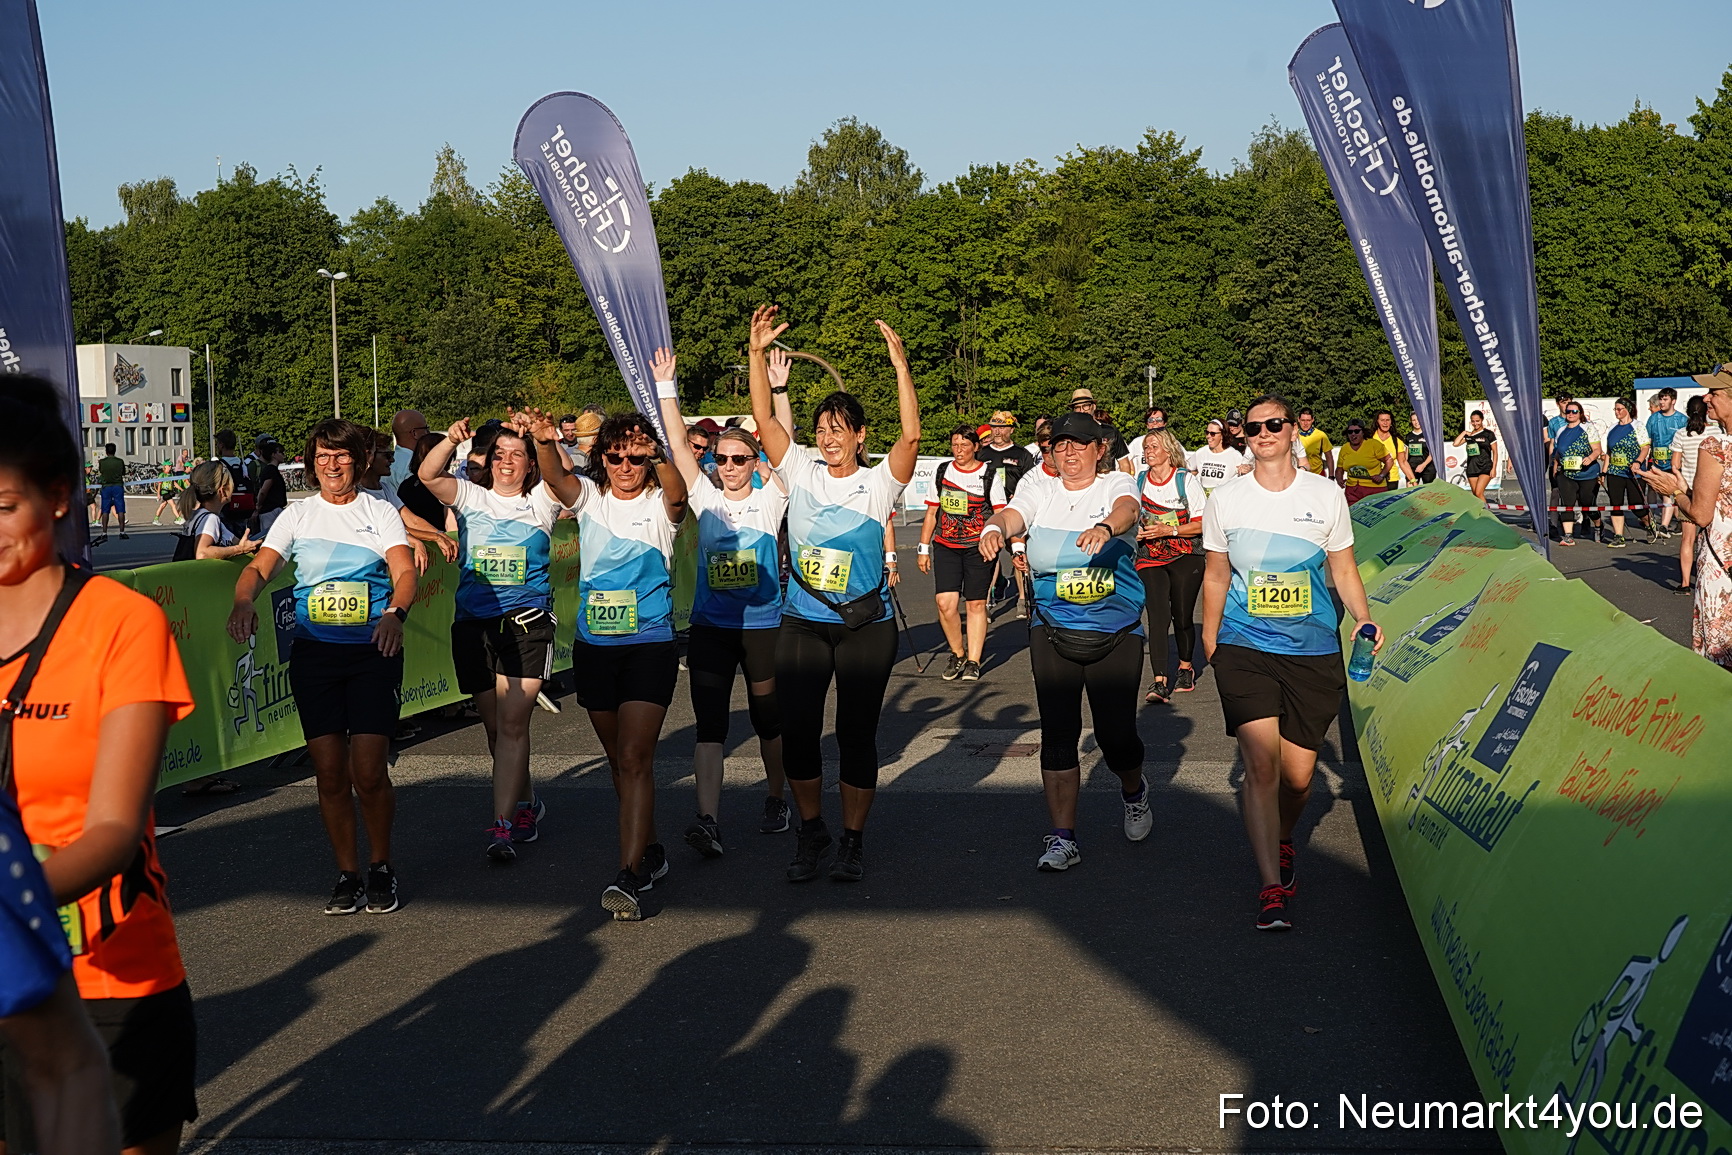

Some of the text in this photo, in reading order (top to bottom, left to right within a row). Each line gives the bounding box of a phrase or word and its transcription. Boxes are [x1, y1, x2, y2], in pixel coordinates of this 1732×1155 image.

[1201, 469, 1224, 479] BLÖD
[945, 498, 960, 507] 158
[481, 559, 518, 572] 1215
[714, 563, 749, 577] 1210
[804, 560, 840, 579] 124
[1066, 581, 1106, 596] 1216
[1259, 587, 1300, 602] 1201
[317, 596, 358, 611] 1209
[591, 605, 628, 620] 1207
[1512, 680, 1540, 707] Fischer
[20, 703, 70, 719] HULE
[1572, 675, 1652, 737] Gesunde
[1639, 692, 1706, 759] Firmen
[1428, 742, 1541, 848] firmenlauf
